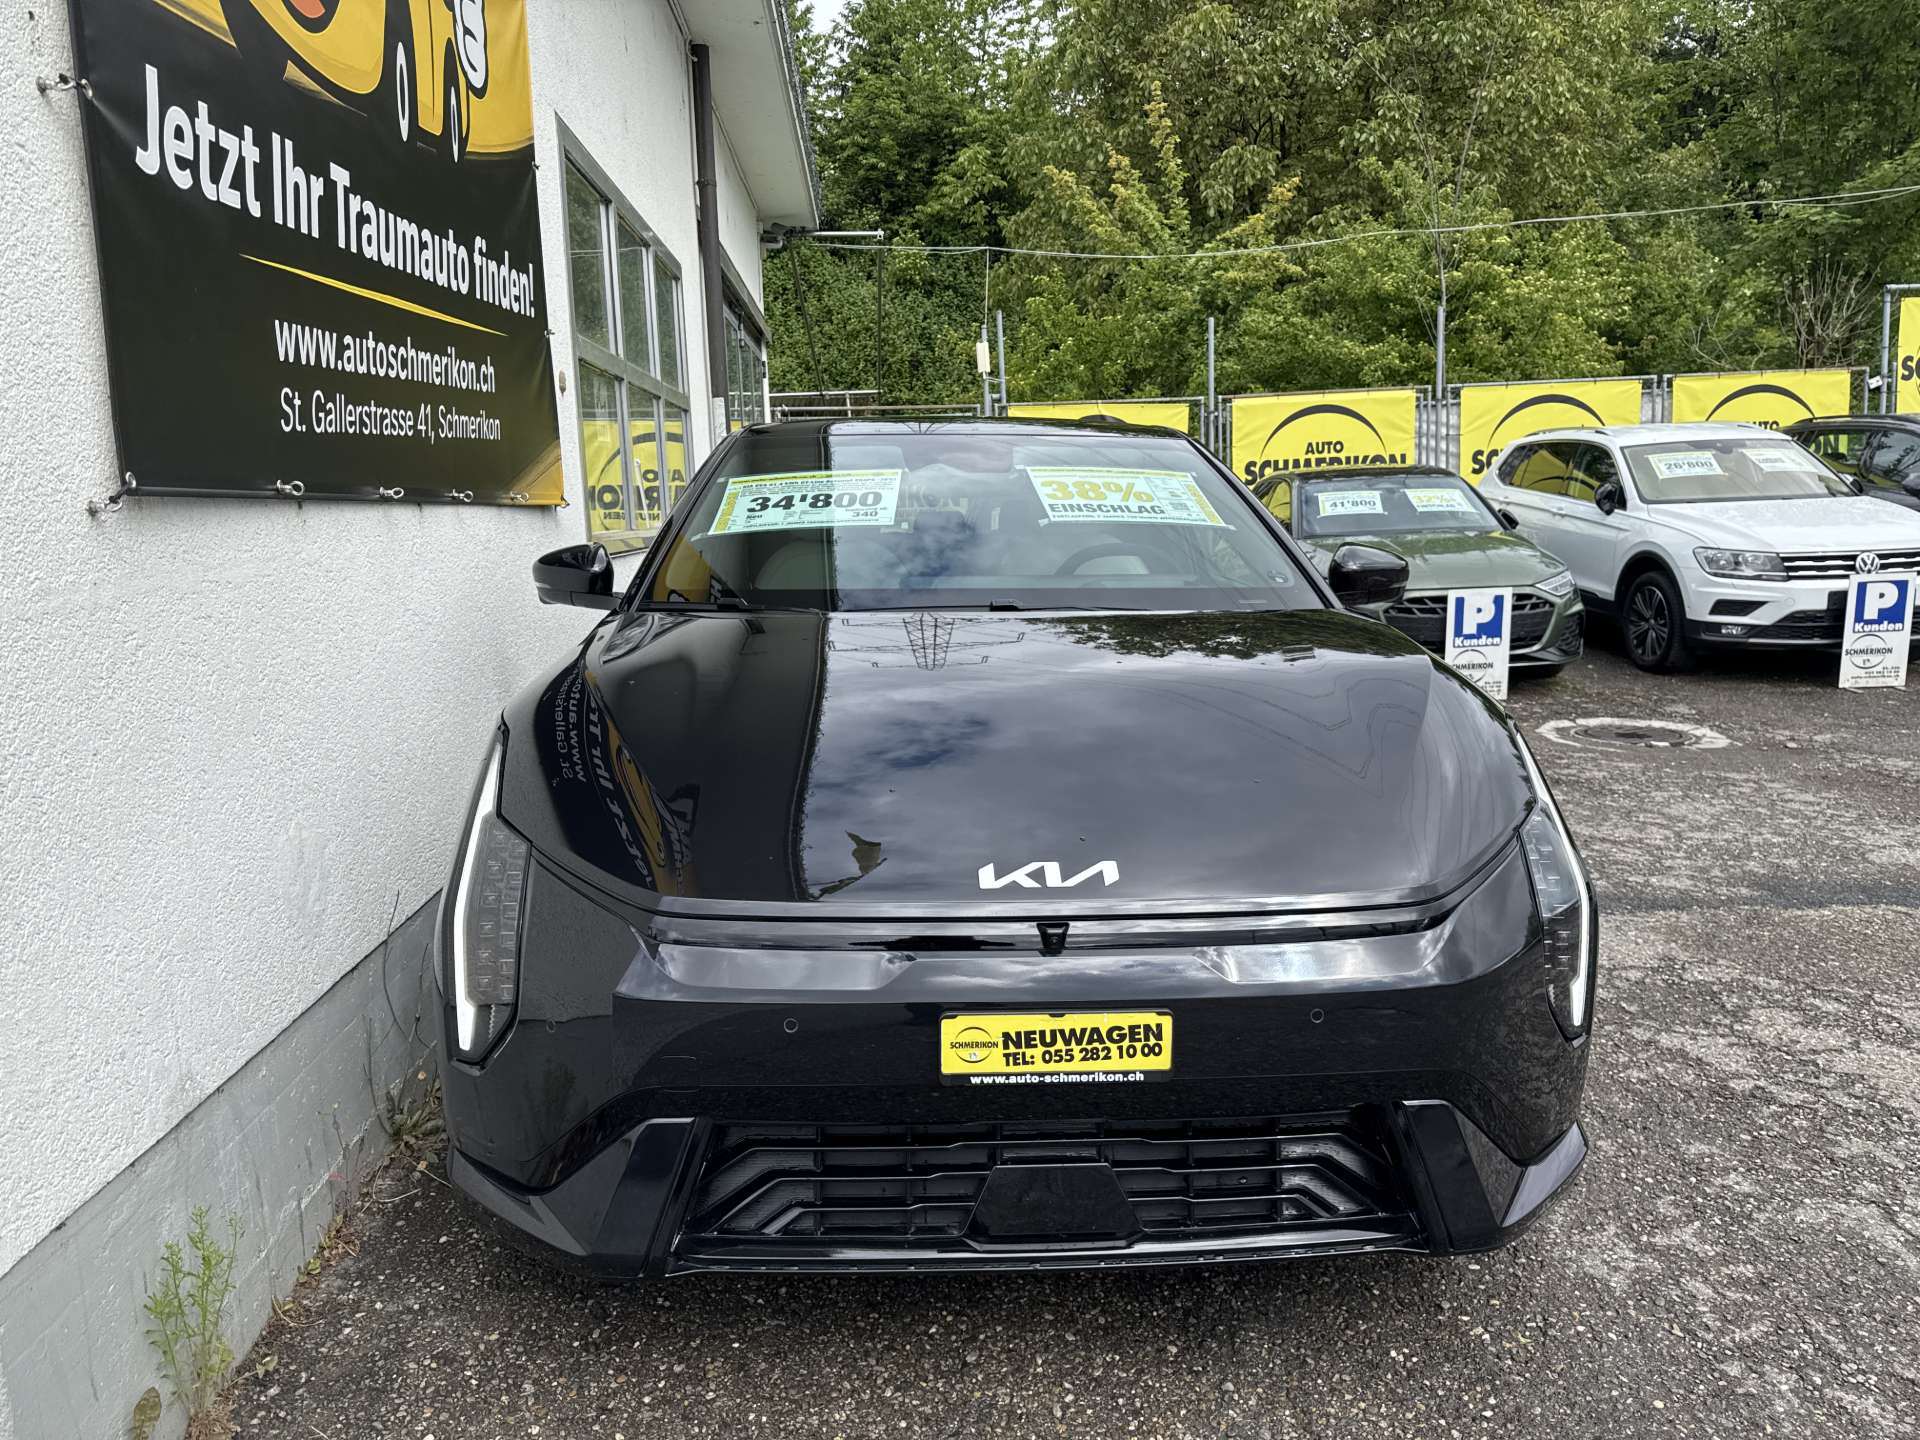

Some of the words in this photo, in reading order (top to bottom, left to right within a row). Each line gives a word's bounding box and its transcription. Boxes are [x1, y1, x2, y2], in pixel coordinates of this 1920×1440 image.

[135, 63, 261, 218] Jetzt
[271, 131, 324, 239] Ihr
[329, 161, 470, 295] Traumauto
[473, 235, 535, 319] finden!
[274, 319, 496, 393] www.autoschmerikon.ch
[280, 387, 306, 432] St.
[311, 389, 414, 436] Gallerstrasse
[417, 402, 435, 444] 41,
[438, 404, 501, 440] Schmerikon
[1304, 440, 1344, 455] AUTO
[1039, 480, 1154, 503] 38%
[746, 491, 883, 513] 34'800
[1048, 503, 1166, 515] EINSCHLAG
[1328, 498, 1377, 509] 41'800
[1854, 620, 1904, 633] Kunden
[1454, 635, 1501, 648] Kunden
[1844, 647, 1894, 656] SCHMERIKON
[1453, 662, 1494, 671] HMERIKON
[978, 860, 1120, 889] KIA
[1001, 1023, 1163, 1050] NEUWAGEN
[950, 1041, 999, 1049] SCHMERIKON
[1003, 1051, 1036, 1067] TEL:
[1041, 1049, 1075, 1064] 055
[1079, 1047, 1112, 1062] 282
[1117, 1045, 1137, 1060] 10
[1140, 1042, 1163, 1057] 00
[970, 1071, 1145, 1084] www.auto-schmerikon.ch
